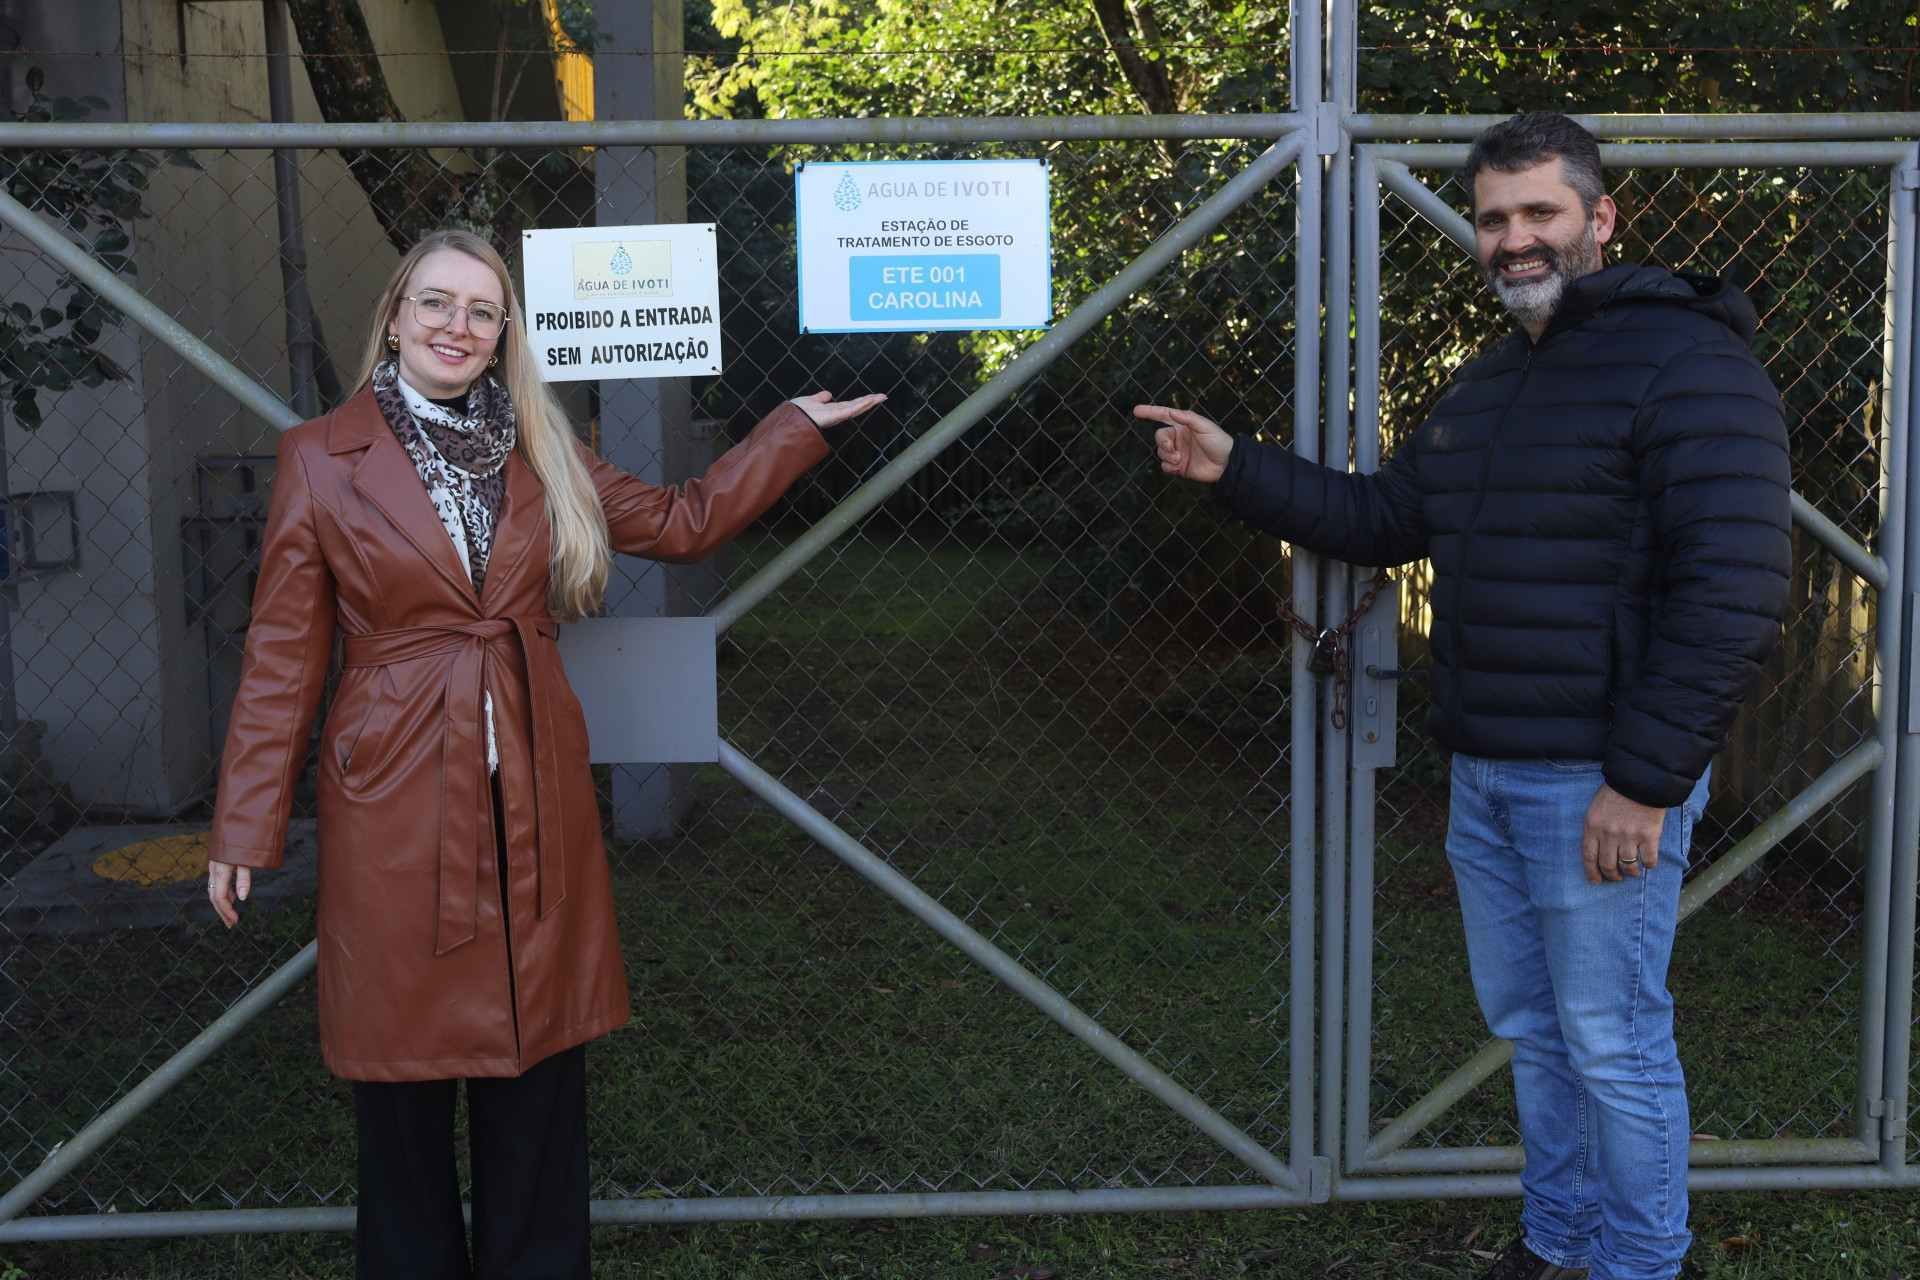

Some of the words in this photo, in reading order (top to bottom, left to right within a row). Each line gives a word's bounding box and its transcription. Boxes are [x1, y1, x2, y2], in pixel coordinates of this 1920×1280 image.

[924, 181, 947, 197] DE
[953, 180, 1010, 197] IVOTI
[881, 218, 947, 234] ESTAÇÃO
[950, 219, 969, 231] DE
[837, 236, 930, 248] TRATAMENTO
[934, 236, 953, 247] DE
[956, 234, 1014, 247] ESGOTO
[882, 266, 925, 284] ETE
[930, 265, 965, 284] 001
[577, 278, 609, 291] ÁGUA
[613, 279, 629, 290] DE
[632, 278, 669, 289] IVOTI
[868, 290, 982, 309] CAROLINA
[536, 310, 614, 331] PROIBIDO
[620, 310, 631, 328] A
[636, 305, 713, 326] ENTRADA
[547, 346, 581, 366] SEM
[591, 336, 709, 364] AUTORIZAÇÃO
